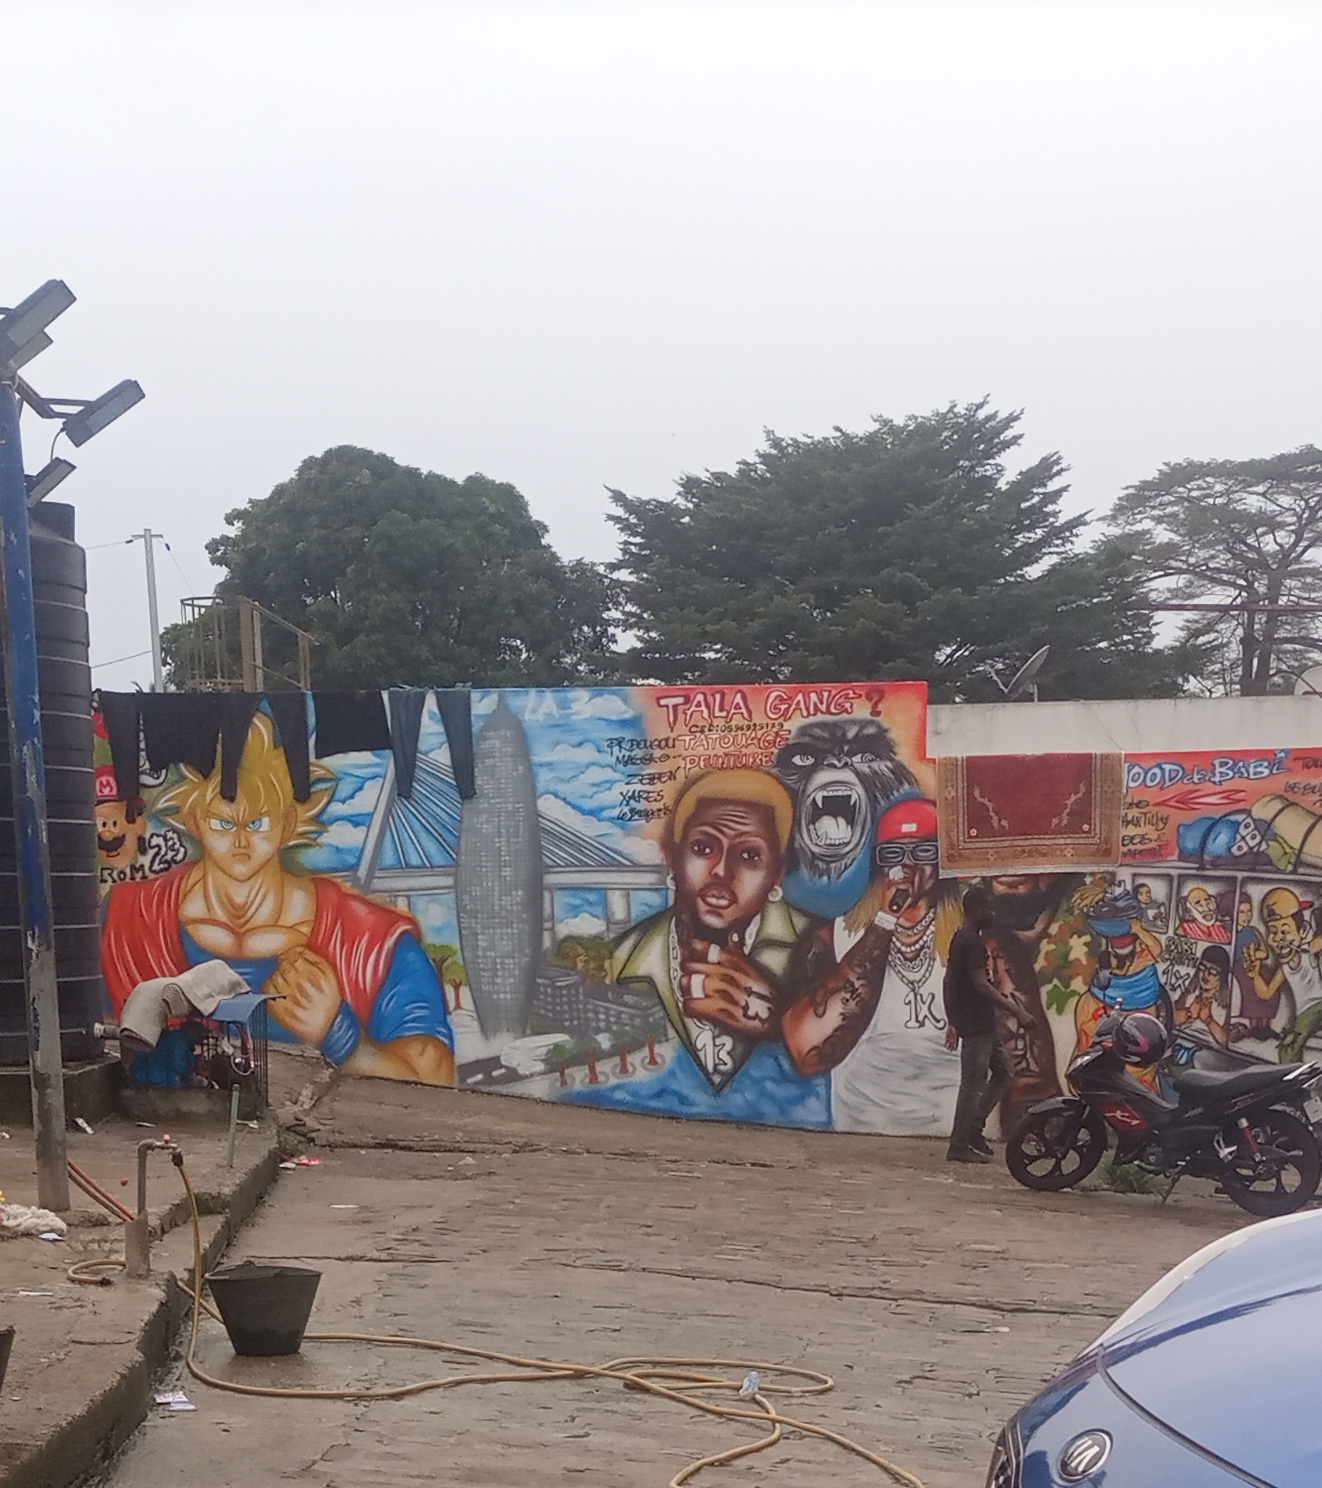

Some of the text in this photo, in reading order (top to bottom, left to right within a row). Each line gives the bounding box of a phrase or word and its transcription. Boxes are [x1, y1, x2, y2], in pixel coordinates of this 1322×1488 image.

[657, 689, 753, 733] TALA
[764, 687, 863, 721] GANG
[677, 729, 792, 751] TATOUAGE
[682, 750, 774, 776] PEINTURE
